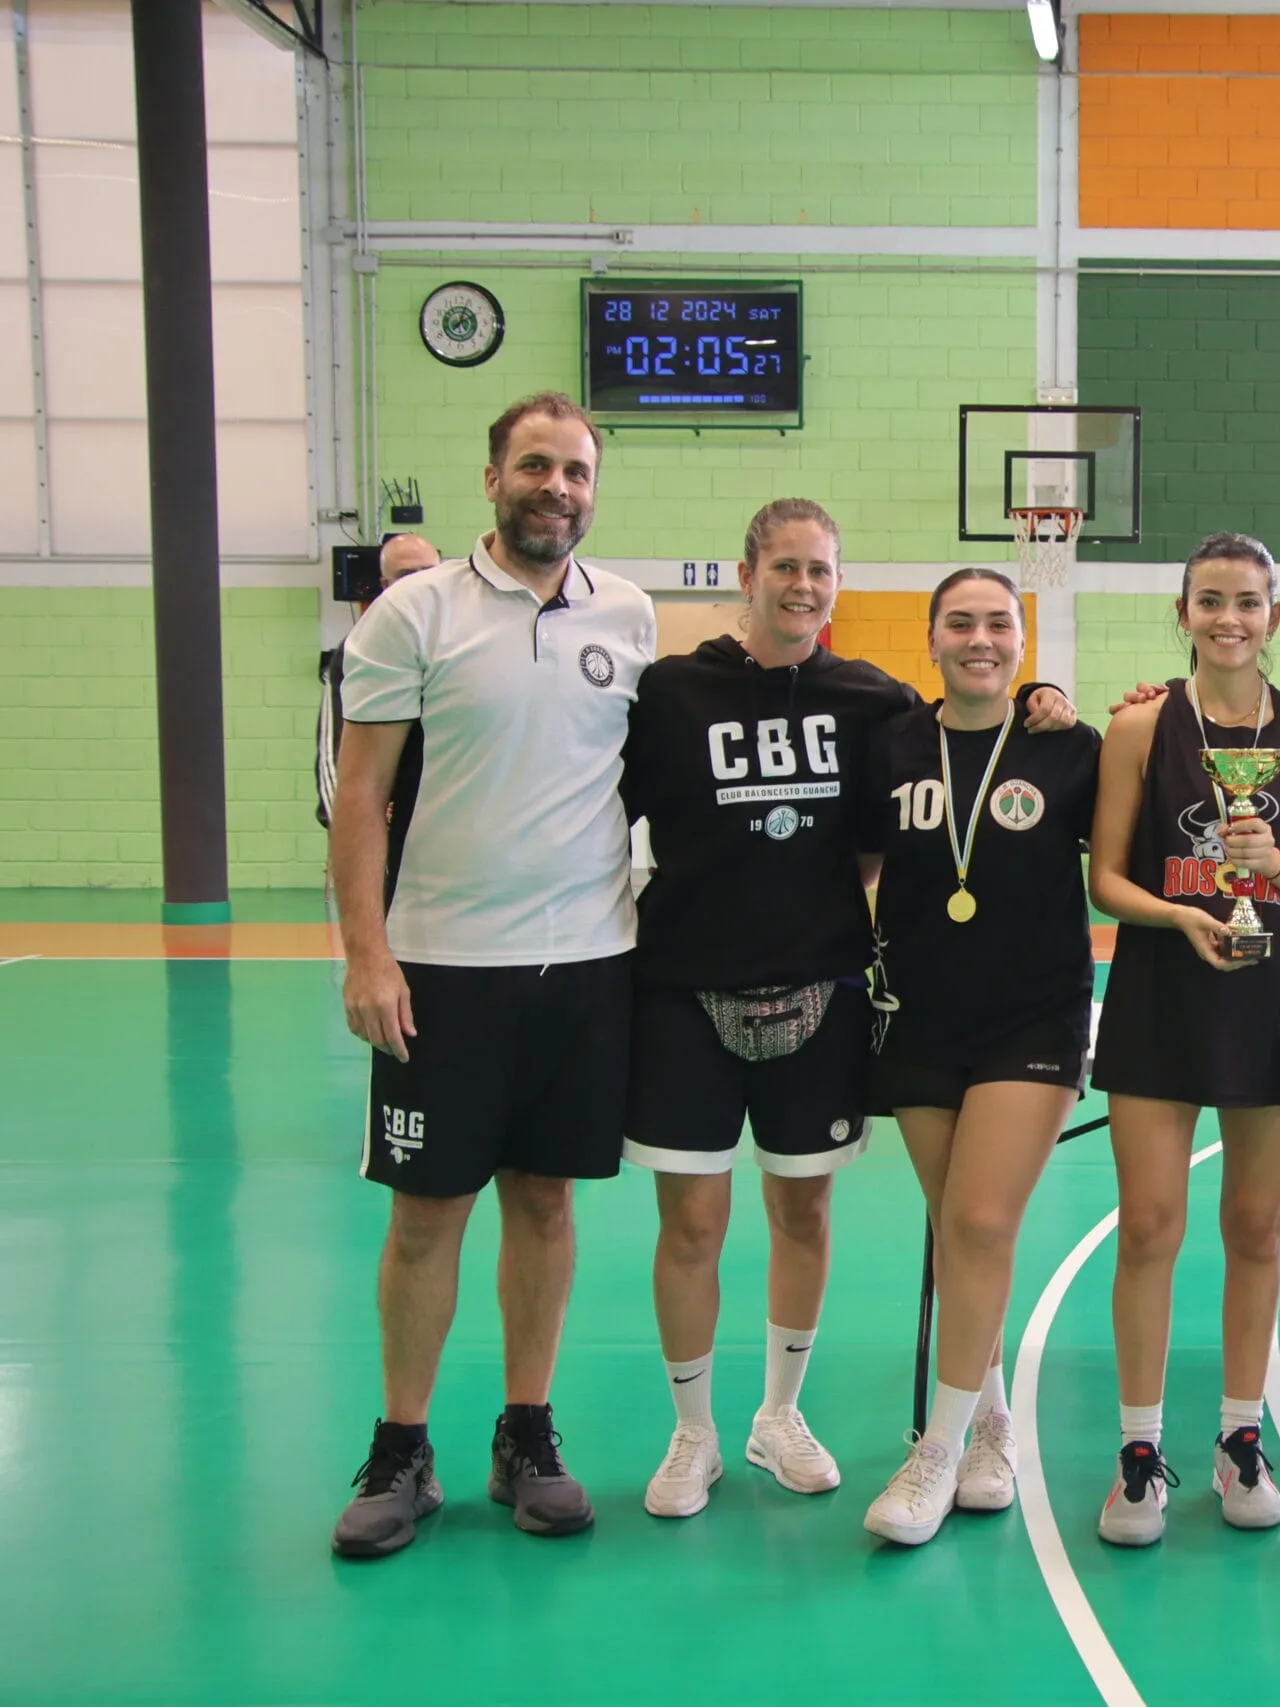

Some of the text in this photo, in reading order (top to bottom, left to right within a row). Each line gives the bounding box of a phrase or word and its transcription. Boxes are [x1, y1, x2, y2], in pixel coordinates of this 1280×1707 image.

[605, 301, 781, 321] 28 12 2024 SAT
[606, 336, 781, 375] PM 02:05 27
[708, 714, 840, 780] CBG
[720, 785, 838, 801] CLUB BALONCESTO GUANCHA
[891, 779, 945, 831] 10
[750, 816, 814, 831] 19 70
[383, 1104, 424, 1139] CBG
